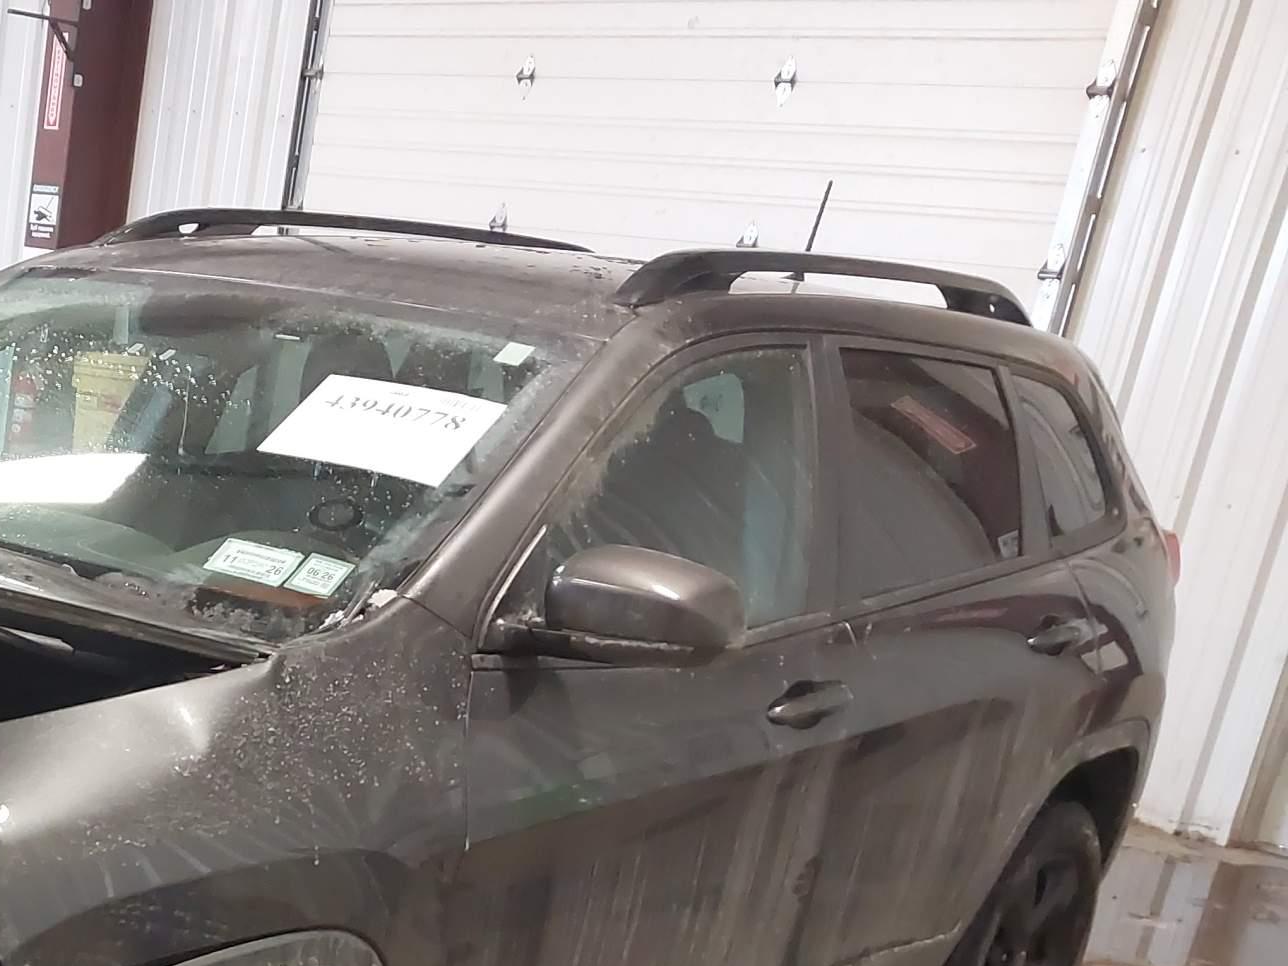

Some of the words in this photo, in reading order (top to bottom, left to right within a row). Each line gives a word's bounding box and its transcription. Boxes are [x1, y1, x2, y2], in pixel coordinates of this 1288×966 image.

[325, 394, 467, 431] 43940778
[265, 565, 285, 576] 26
[306, 567, 320, 577] 06
[320, 571, 335, 581] 26
